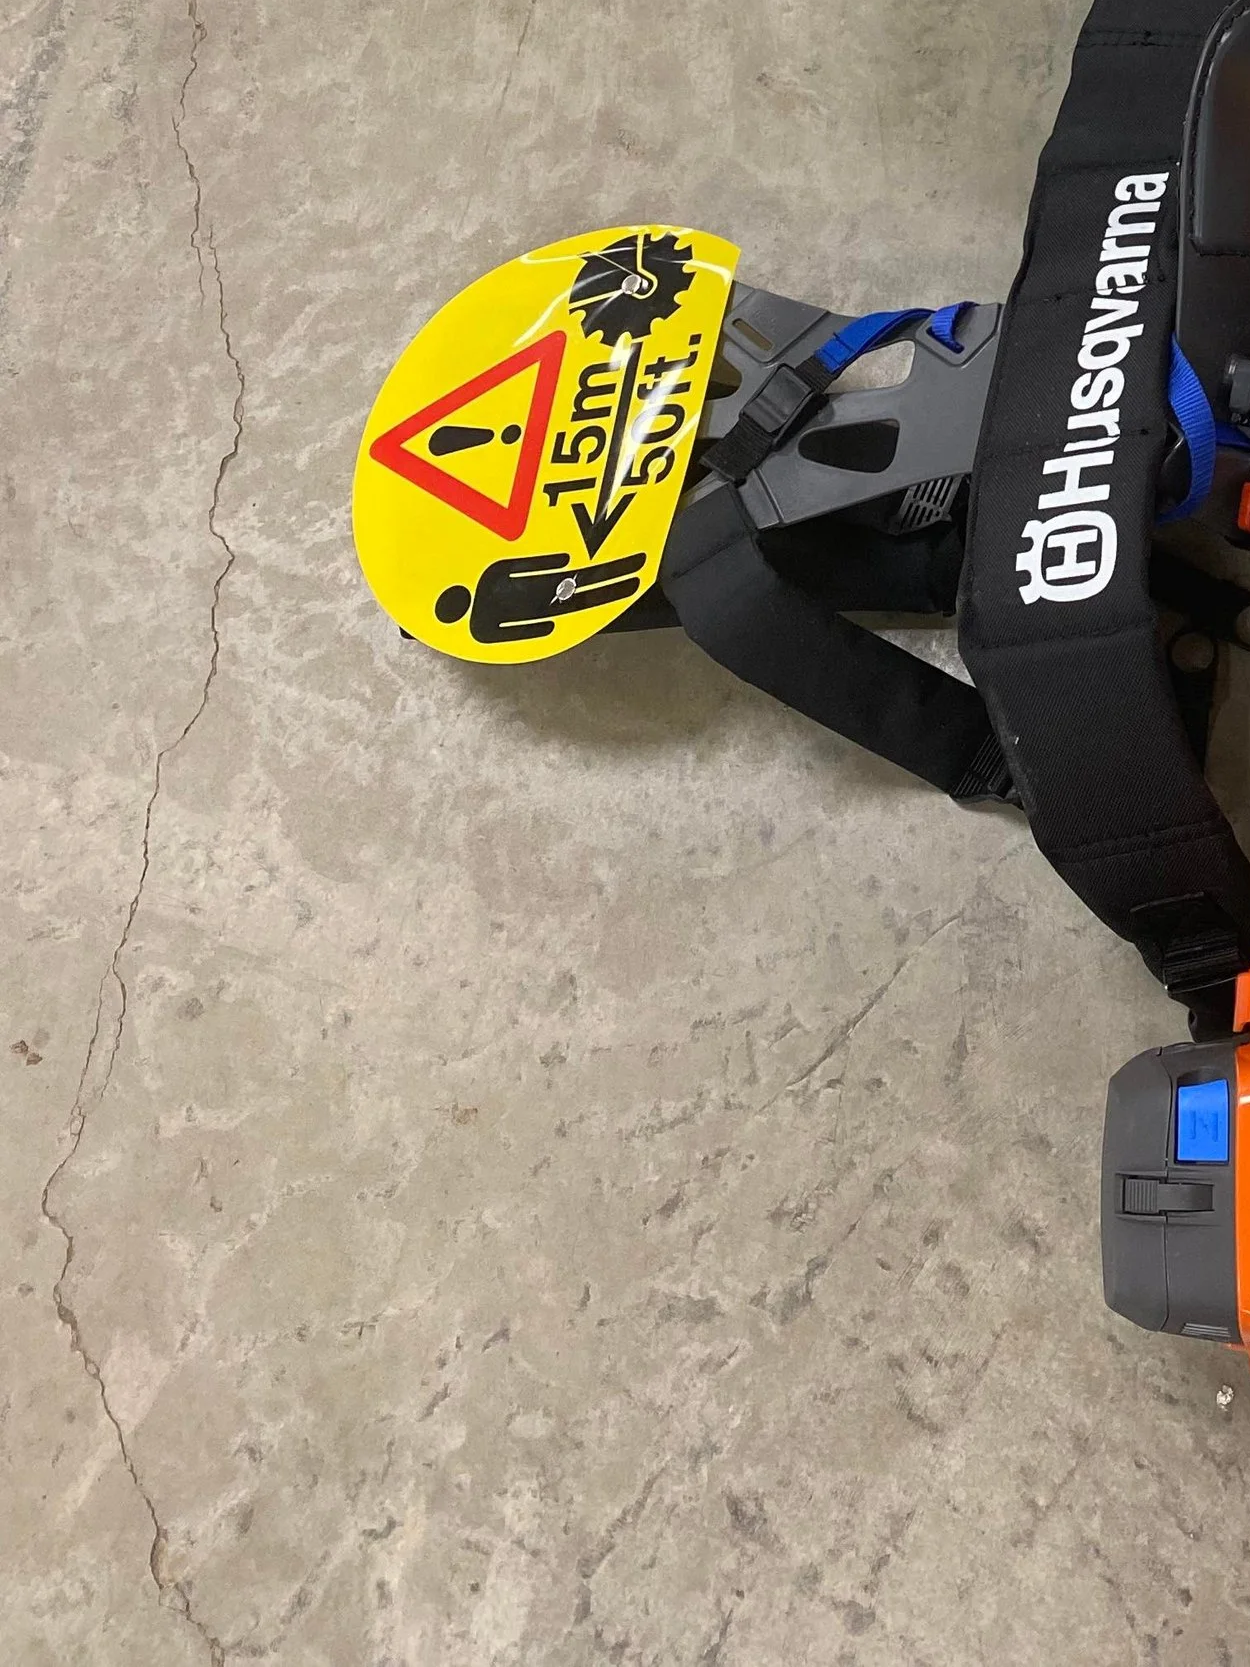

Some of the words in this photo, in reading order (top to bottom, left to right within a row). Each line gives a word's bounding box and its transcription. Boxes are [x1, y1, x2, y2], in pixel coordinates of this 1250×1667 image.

[630, 333, 702, 483] 50ft.
[1038, 171, 1170, 509] Husqvarna
[542, 360, 622, 508] 15m
